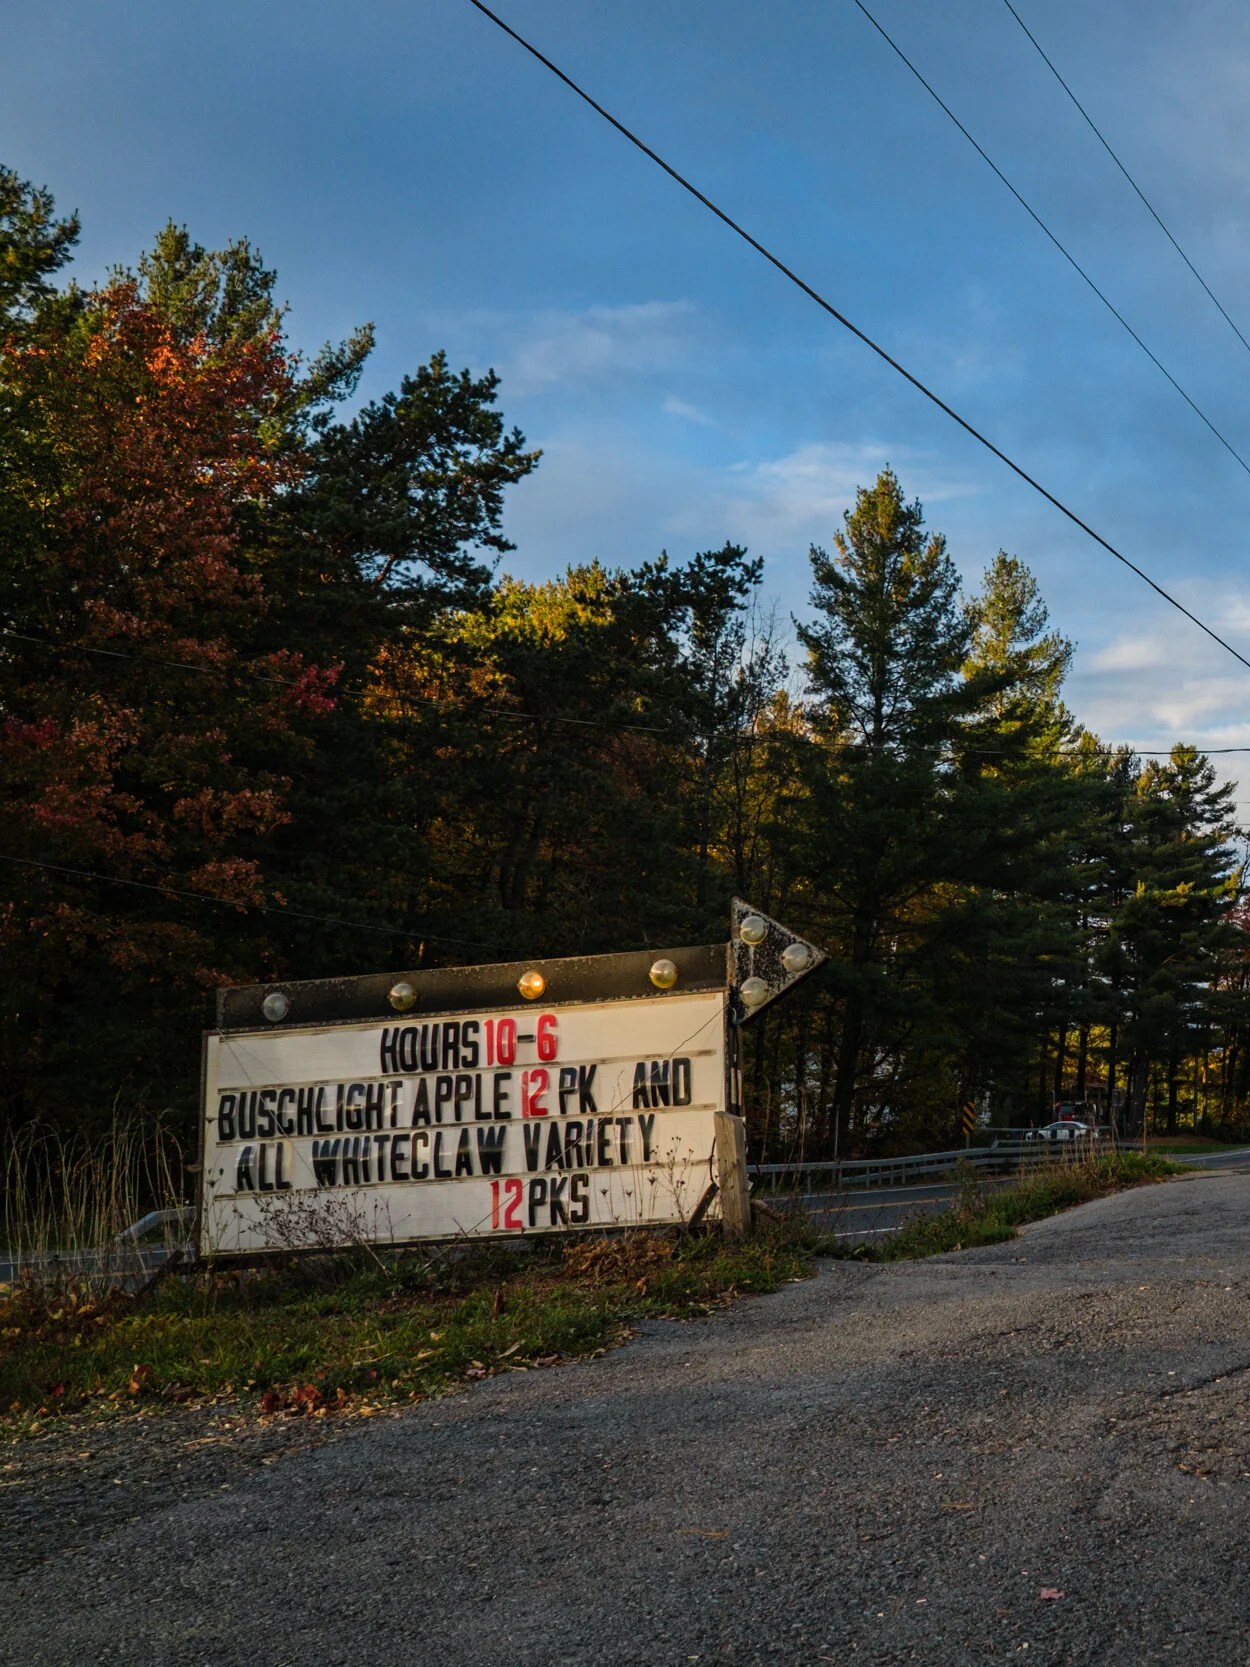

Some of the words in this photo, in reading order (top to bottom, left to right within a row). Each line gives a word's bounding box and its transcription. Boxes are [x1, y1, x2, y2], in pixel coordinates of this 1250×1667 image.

[380, 1020, 480, 1073] HOURS
[483, 1013, 557, 1067] 10-6
[411, 1072, 511, 1126] APPLE
[520, 1068, 549, 1120] 12
[558, 1064, 597, 1115] PK
[632, 1057, 692, 1110] AND
[236, 1141, 294, 1192] ALL
[522, 1113, 656, 1173] VARIETY
